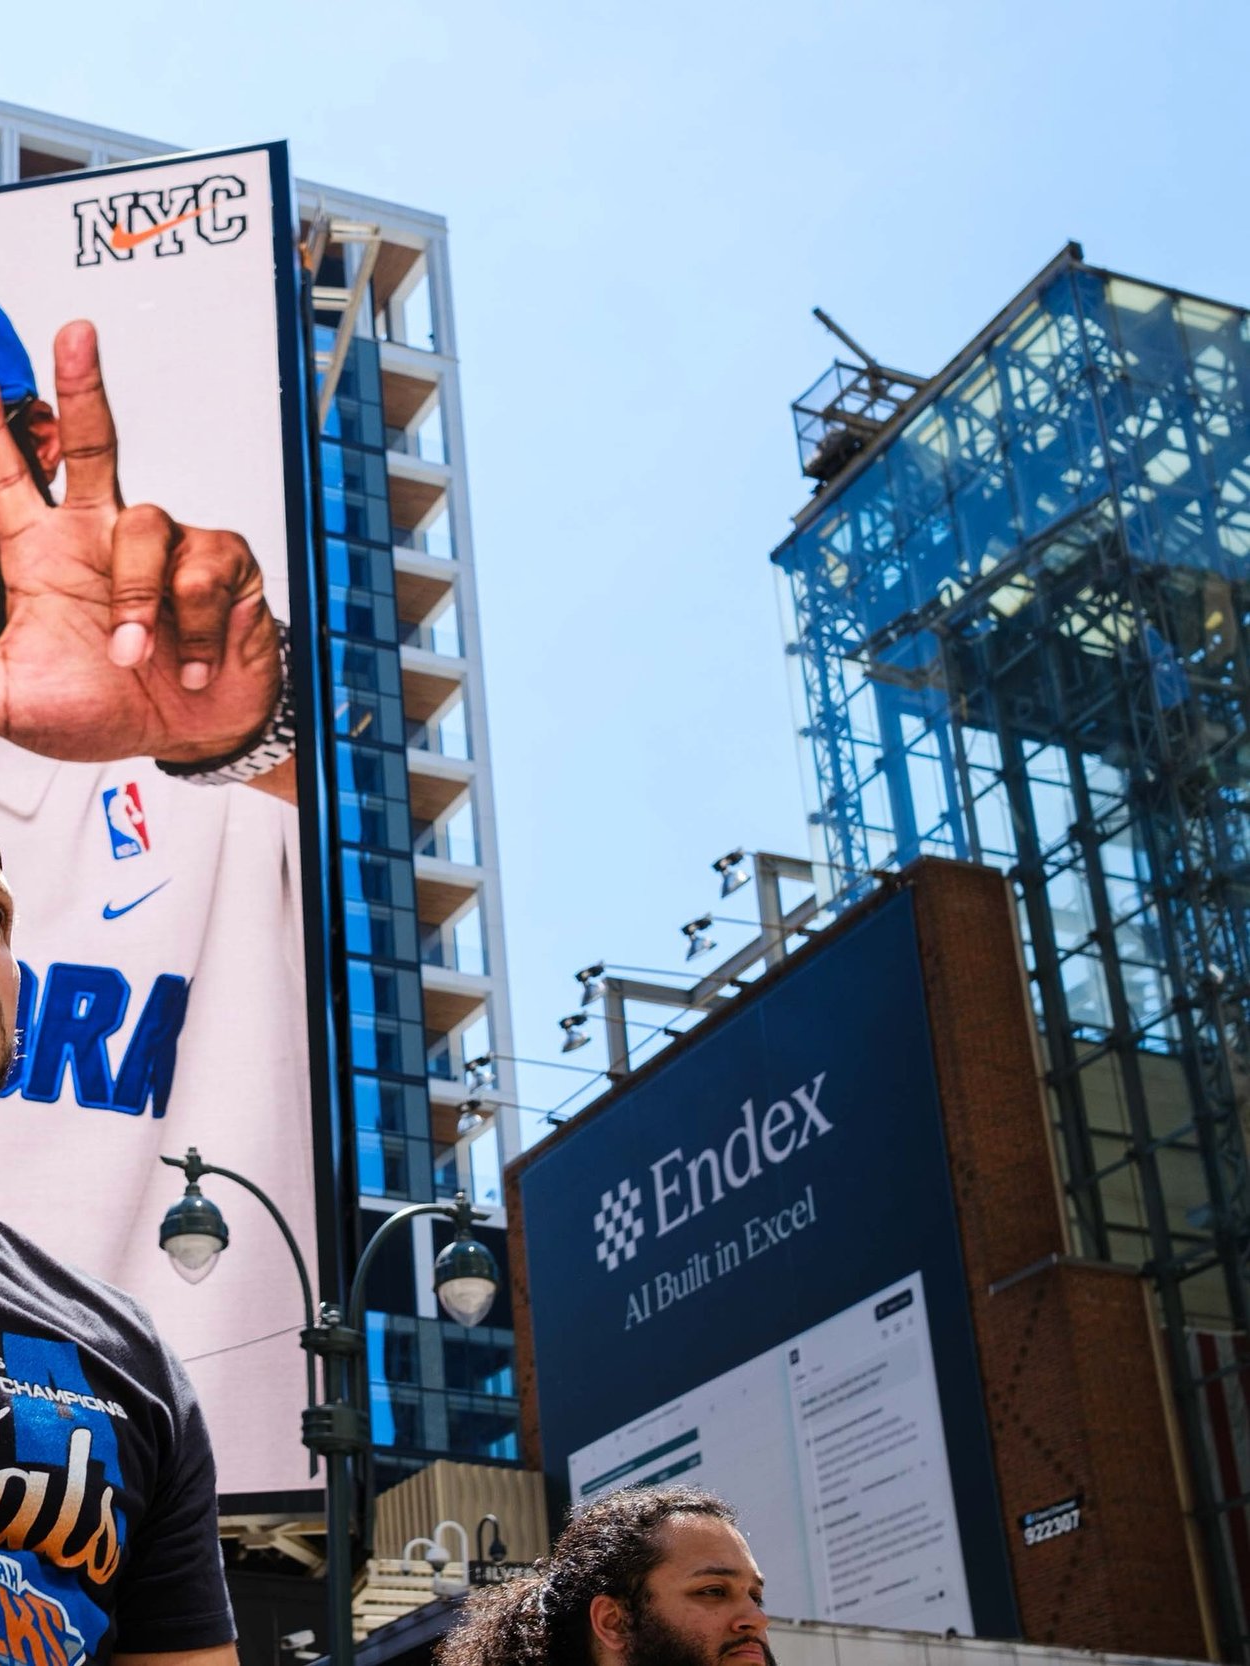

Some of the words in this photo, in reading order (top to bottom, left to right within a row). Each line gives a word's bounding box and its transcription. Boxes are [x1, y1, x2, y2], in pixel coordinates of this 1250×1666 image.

[73, 175, 247, 267] NYC
[650, 1071, 834, 1238] Endex
[624, 1282, 652, 1331] AI
[654, 1253, 711, 1311] Built
[714, 1241, 741, 1276] in
[743, 1184, 817, 1260] Excel
[0, 1376, 129, 1419] CHAMPIONS
